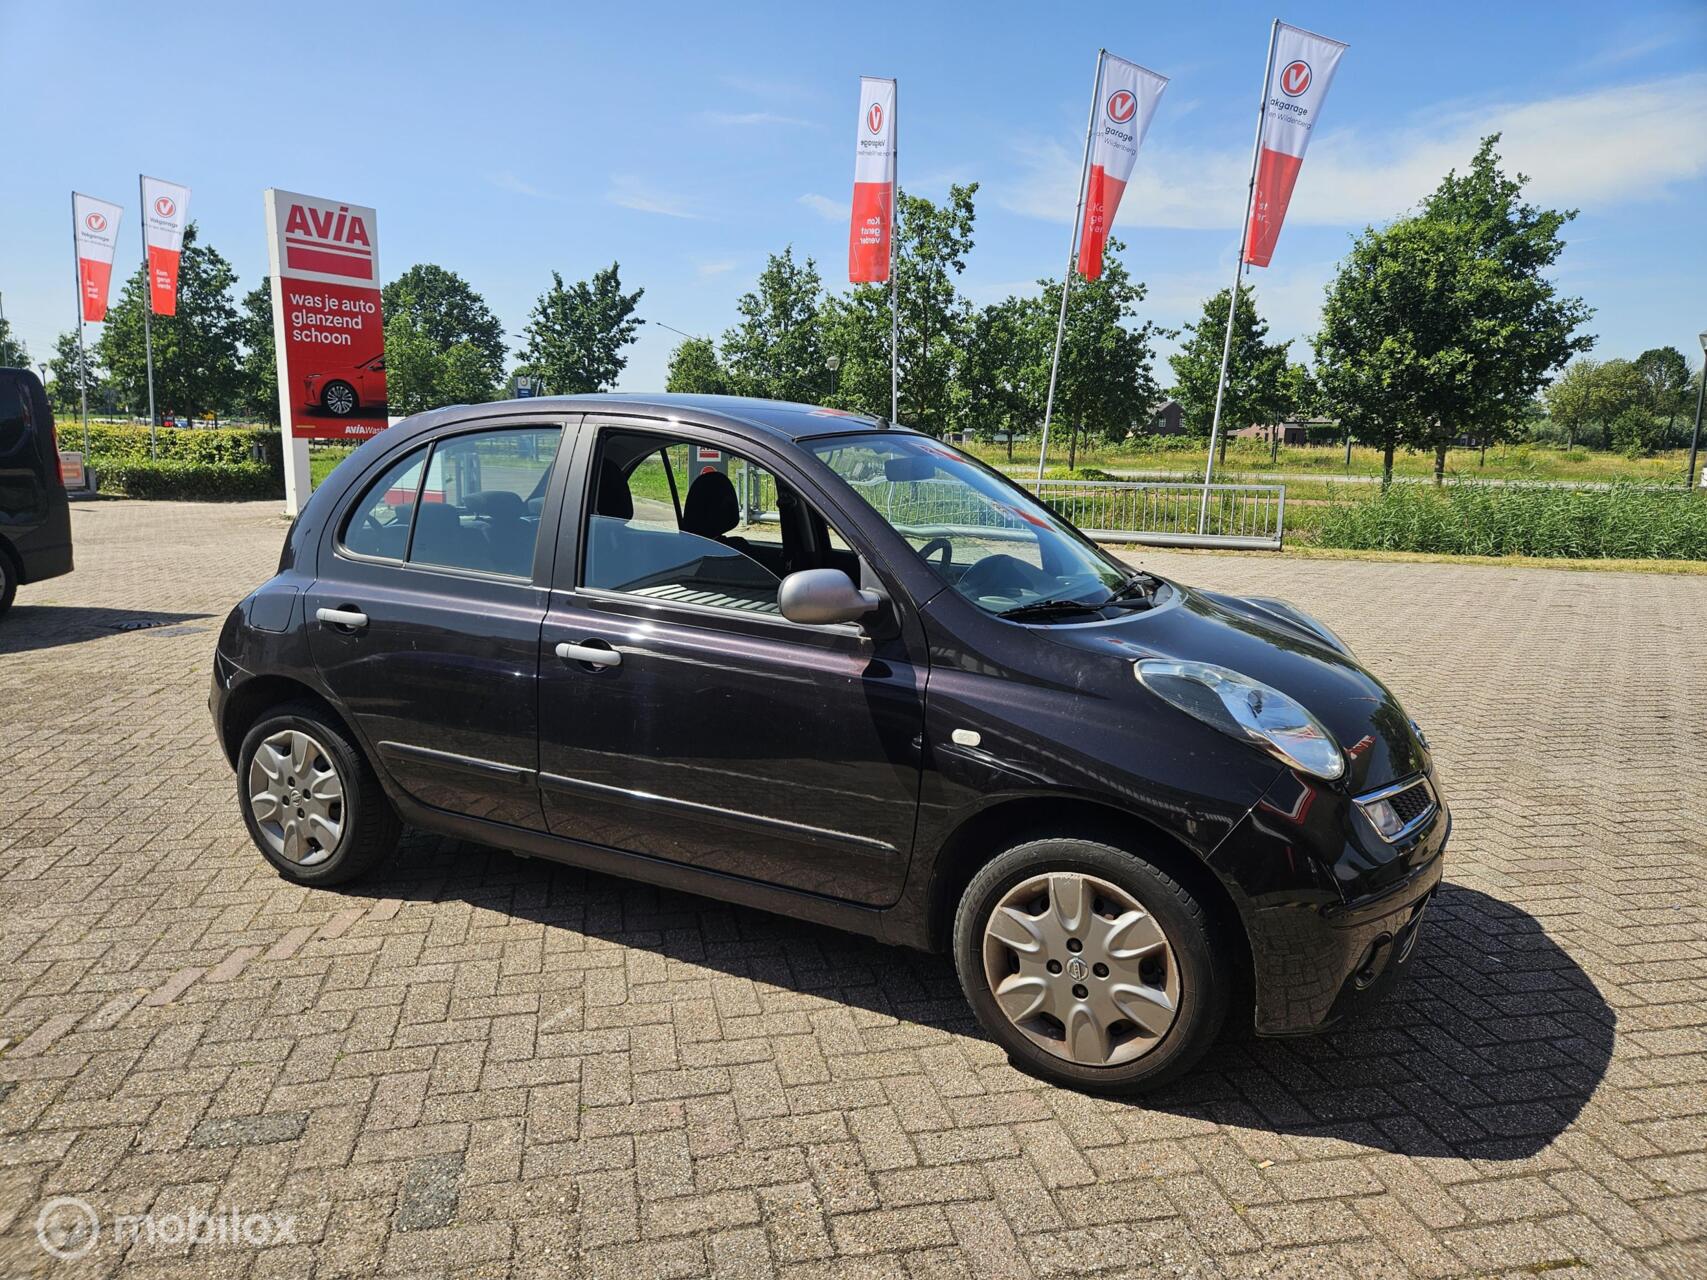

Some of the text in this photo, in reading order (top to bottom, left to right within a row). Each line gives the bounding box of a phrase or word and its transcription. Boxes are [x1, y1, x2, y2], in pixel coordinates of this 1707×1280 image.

[1270, 97, 1308, 116] akgarage
[1104, 126, 1133, 142] garage
[289, 293, 375, 314] was je auto
[291, 309, 362, 329] glanzend
[292, 327, 351, 345] schoon
